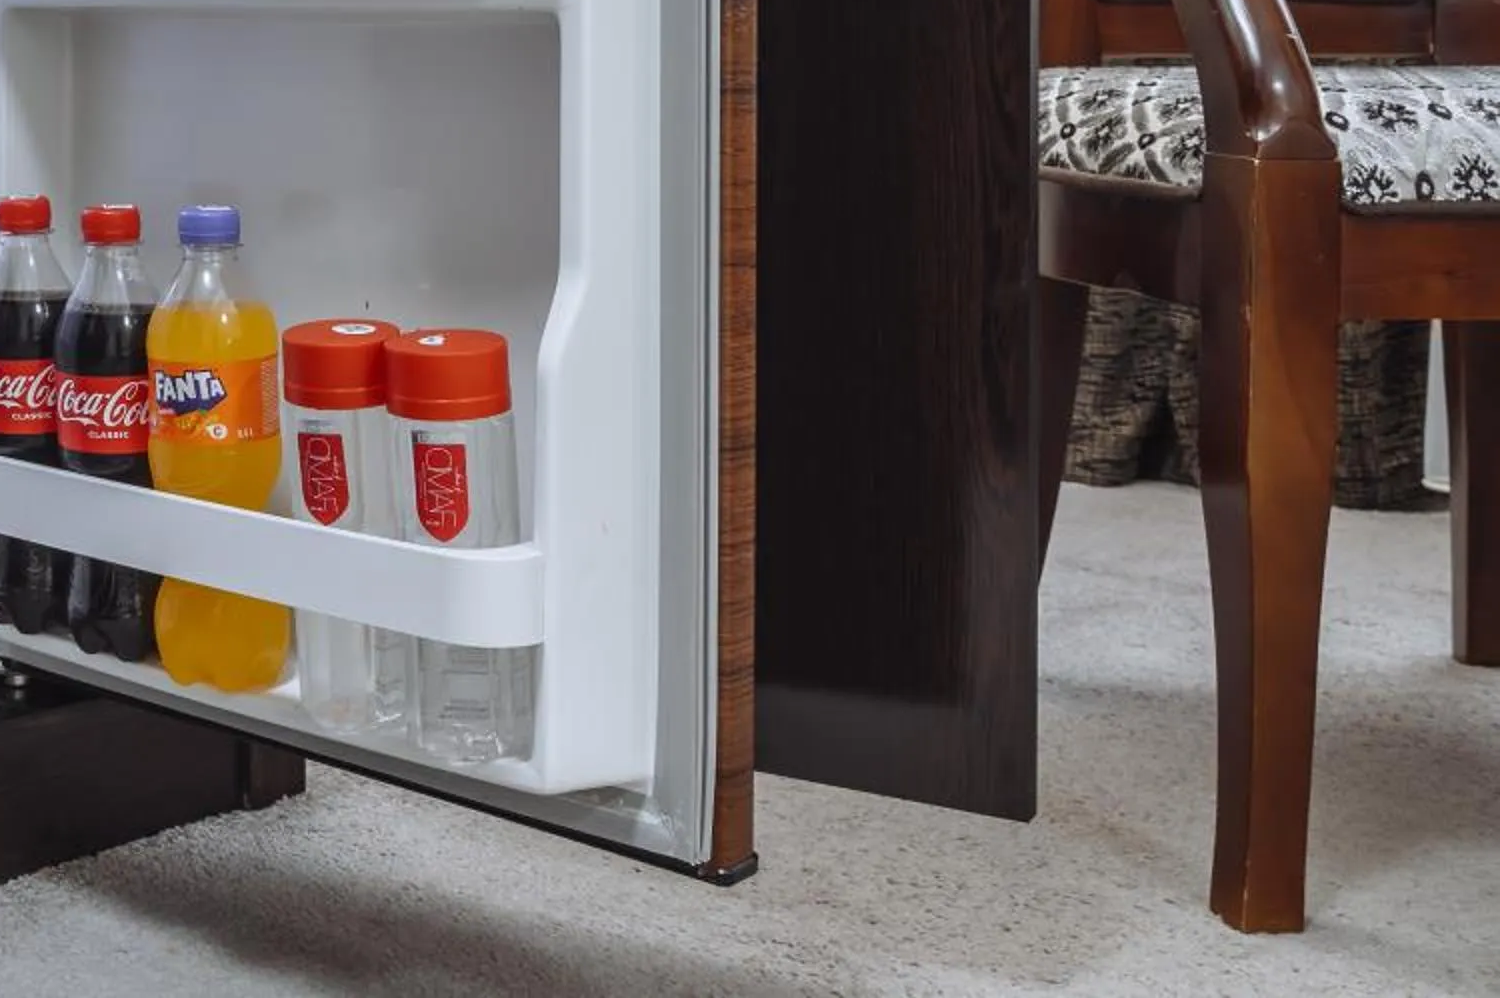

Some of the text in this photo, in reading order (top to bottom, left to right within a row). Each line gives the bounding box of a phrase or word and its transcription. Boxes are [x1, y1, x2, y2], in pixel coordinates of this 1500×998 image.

[155, 370, 225, 402] FANTA
[58, 378, 148, 427] Coca-Col
[88, 431, 130, 439] CLASSIC
